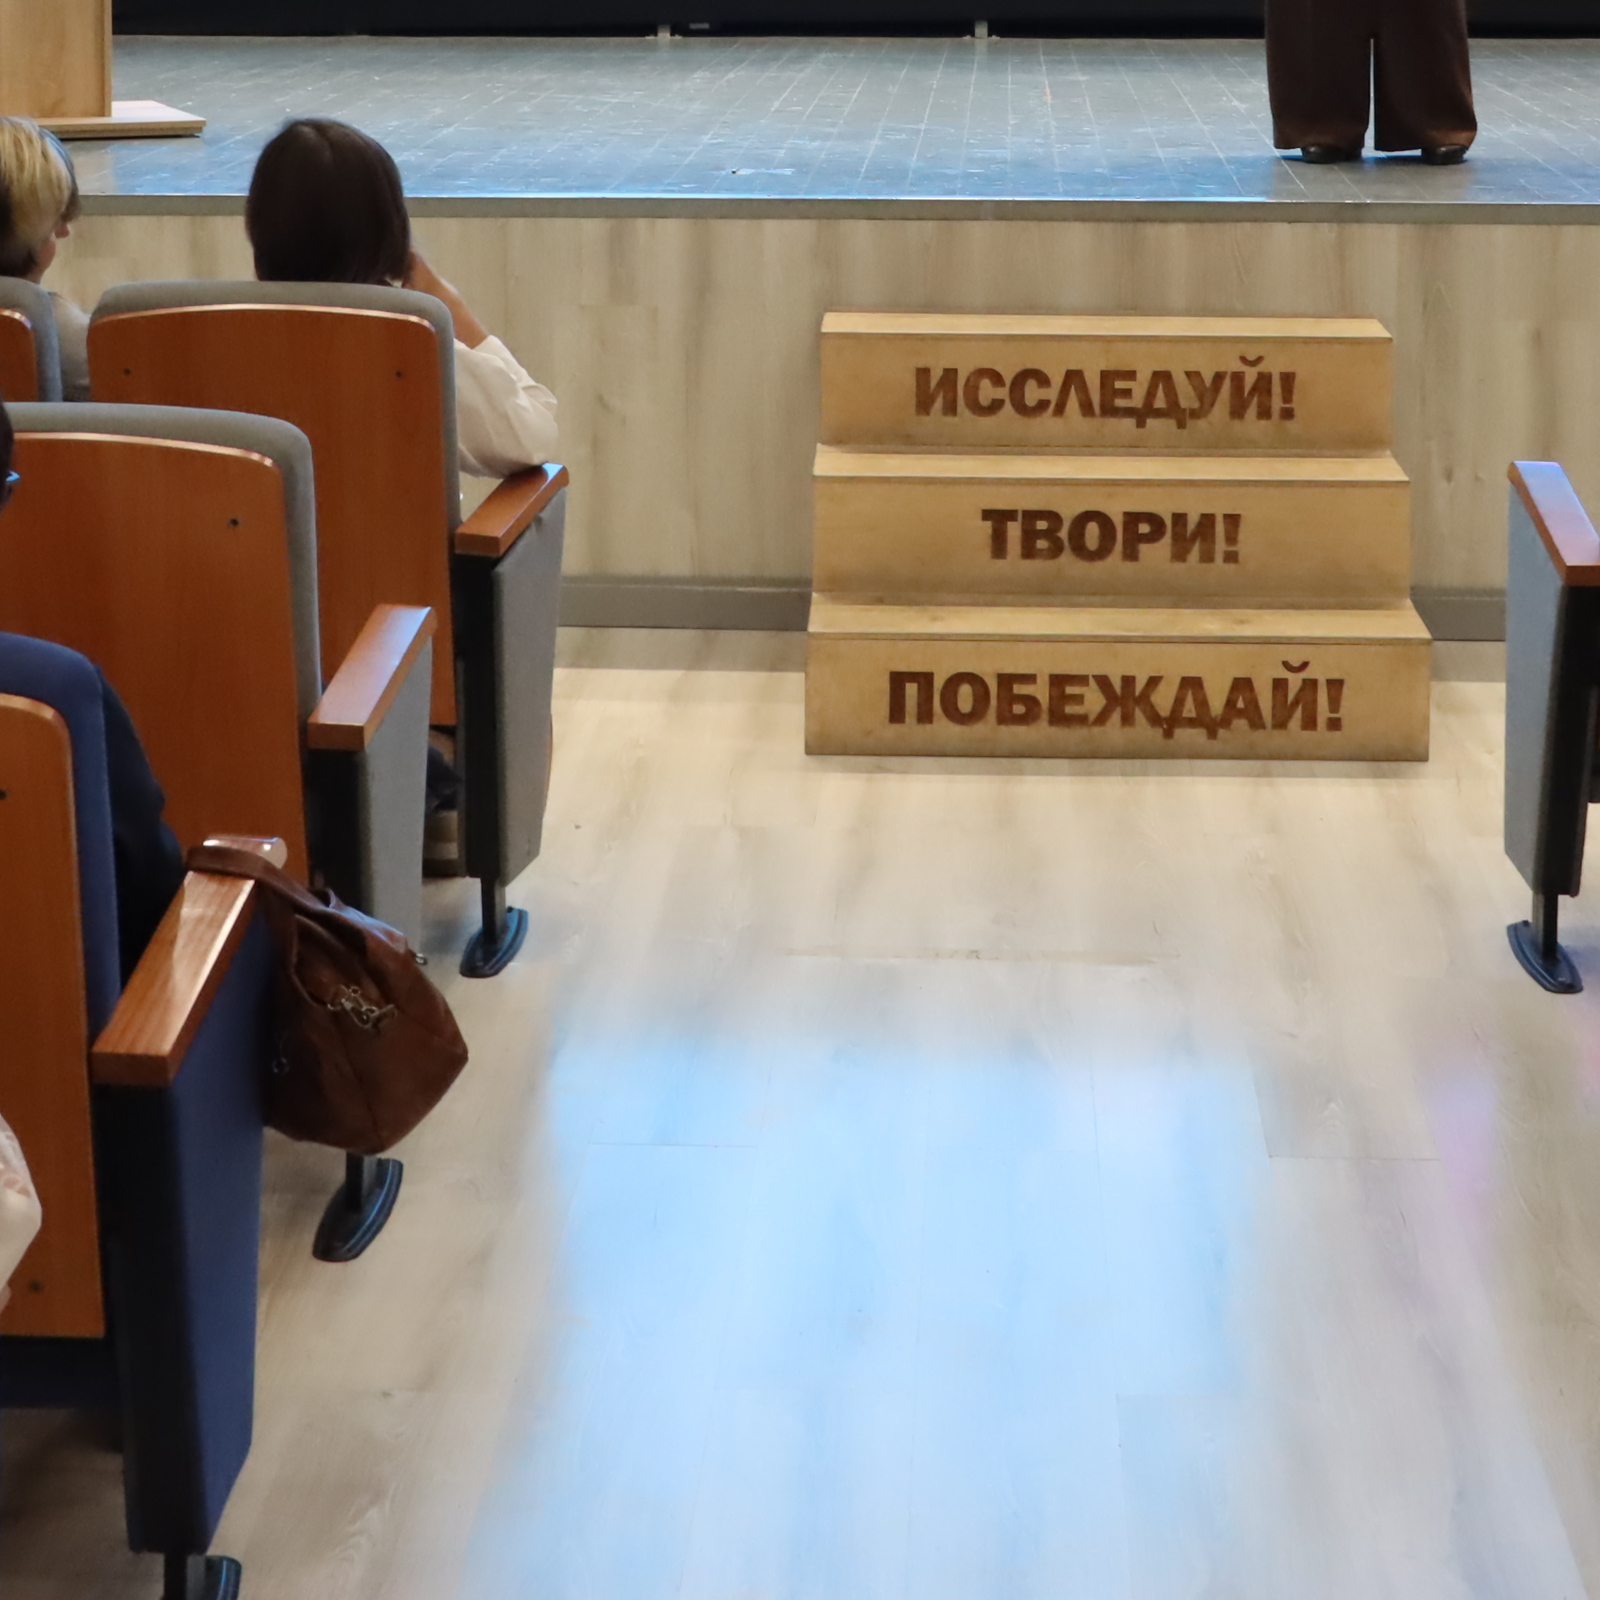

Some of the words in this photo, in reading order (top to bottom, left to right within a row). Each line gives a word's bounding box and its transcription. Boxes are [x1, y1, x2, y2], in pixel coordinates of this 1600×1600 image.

[915, 355, 1296, 428] ИССЛЕДУЙ!
[981, 509, 1241, 564] ТВОРИ!
[888, 661, 1344, 741] ПОБЕЖДАЙ!
